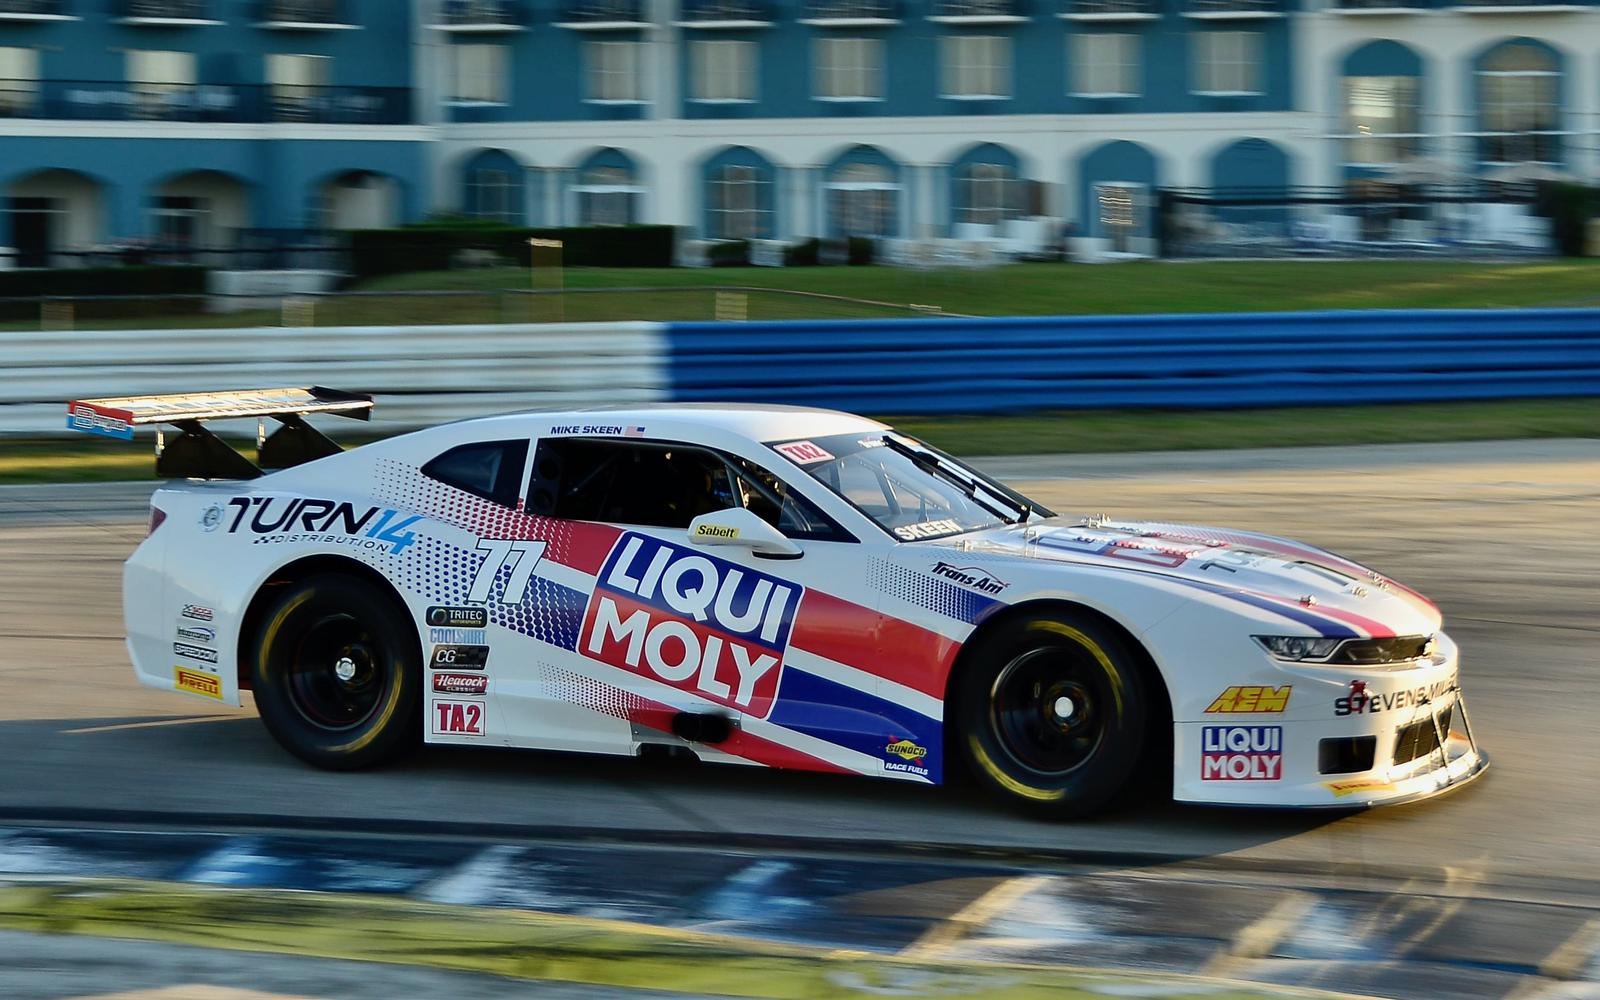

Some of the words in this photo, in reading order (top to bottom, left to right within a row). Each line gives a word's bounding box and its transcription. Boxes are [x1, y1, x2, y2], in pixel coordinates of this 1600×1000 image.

[550, 427, 580, 435] MIKE
[582, 426, 622, 435] SKEEN
[784, 444, 826, 461] TA2
[698, 525, 735, 537] Sabelt
[894, 519, 964, 541] SKEEN
[275, 534, 389, 552] DISTRIBUTION
[467, 538, 548, 605] 77
[931, 561, 976, 585] Trans
[972, 577, 1003, 594] Am
[607, 536, 792, 644] LIQUI
[449, 609, 483, 620] TRITEC
[430, 628, 486, 644] COOLSHIRT
[436, 649, 456, 663] CG
[588, 596, 779, 706] MOLY
[178, 671, 218, 695] PIRELLI
[438, 675, 485, 687] Heacock
[1203, 685, 1292, 713] AEM
[1334, 692, 1426, 716] STEVENS
[437, 703, 480, 733] TA2
[888, 745, 925, 756] SUNOCO
[1205, 728, 1280, 752] LIQUI
[885, 762, 907, 771] RACE
[907, 765, 928, 776] FUELS
[1204, 754, 1281, 779] MOLY
